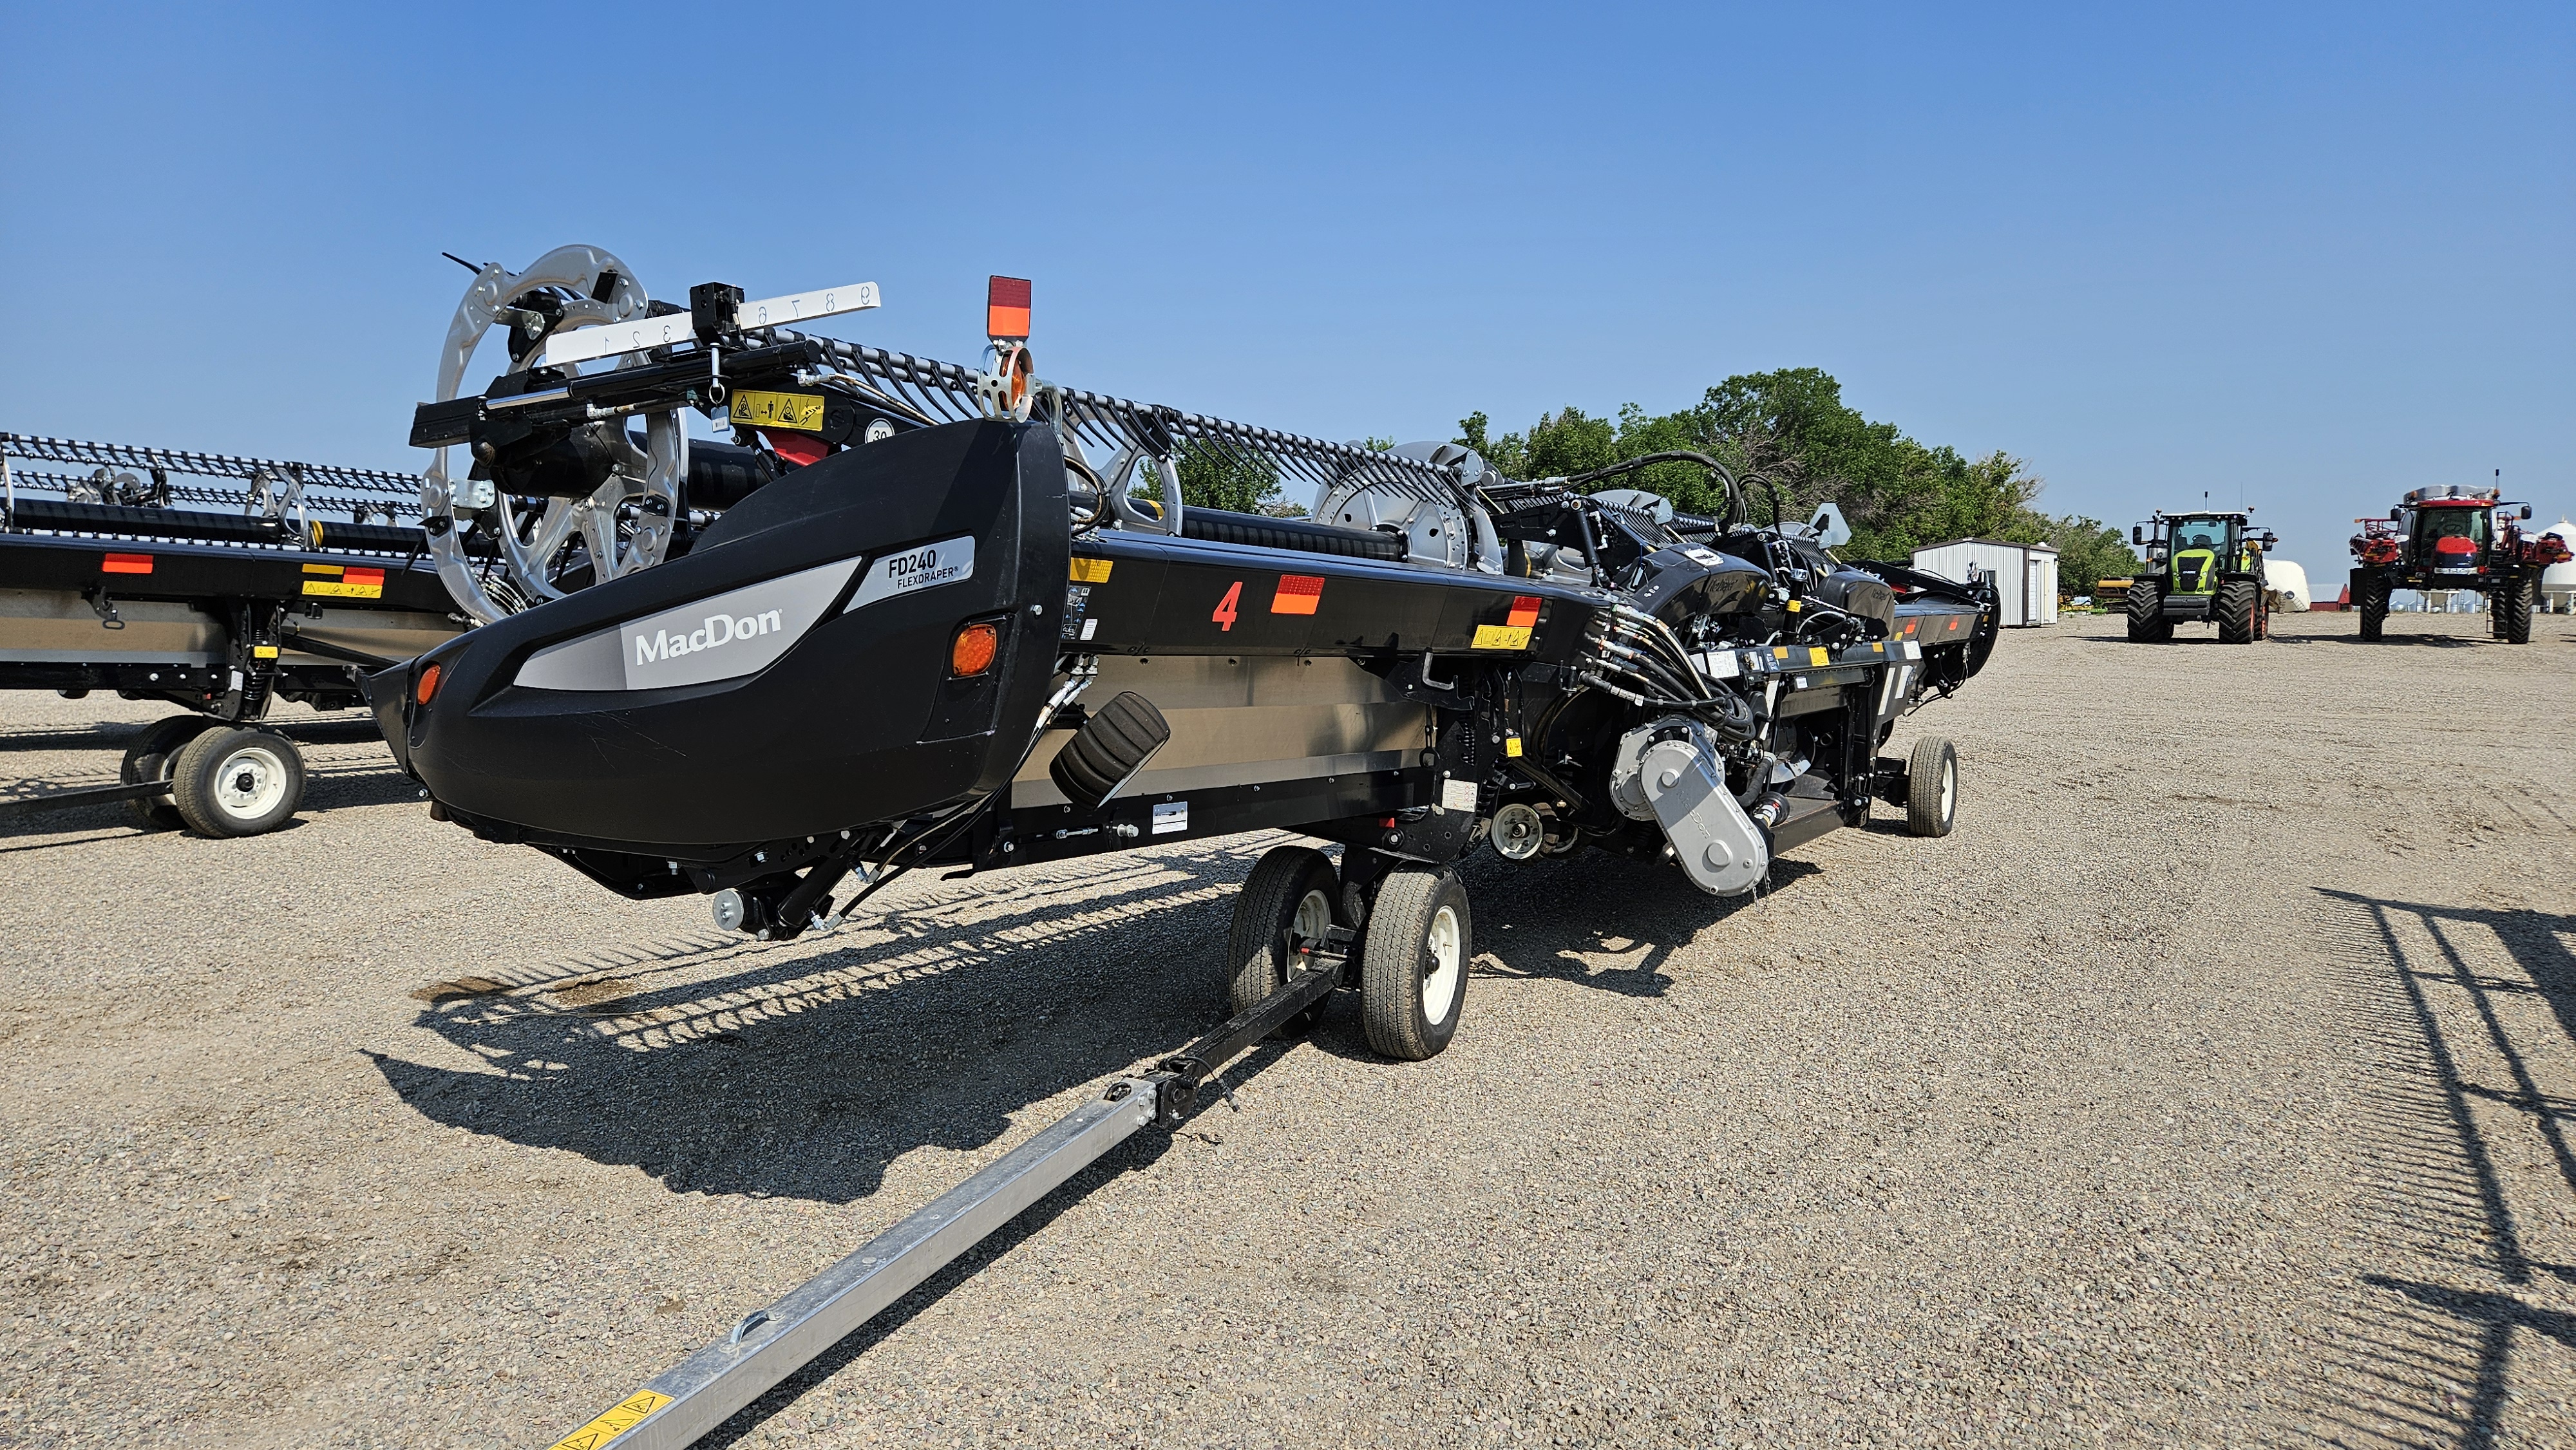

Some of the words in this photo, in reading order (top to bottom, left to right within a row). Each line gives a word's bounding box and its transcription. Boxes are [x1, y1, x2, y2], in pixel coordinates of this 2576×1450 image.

[889, 549, 936, 578] FD240
[1212, 581, 1243, 631] 4
[636, 609, 782, 666] MacDon
